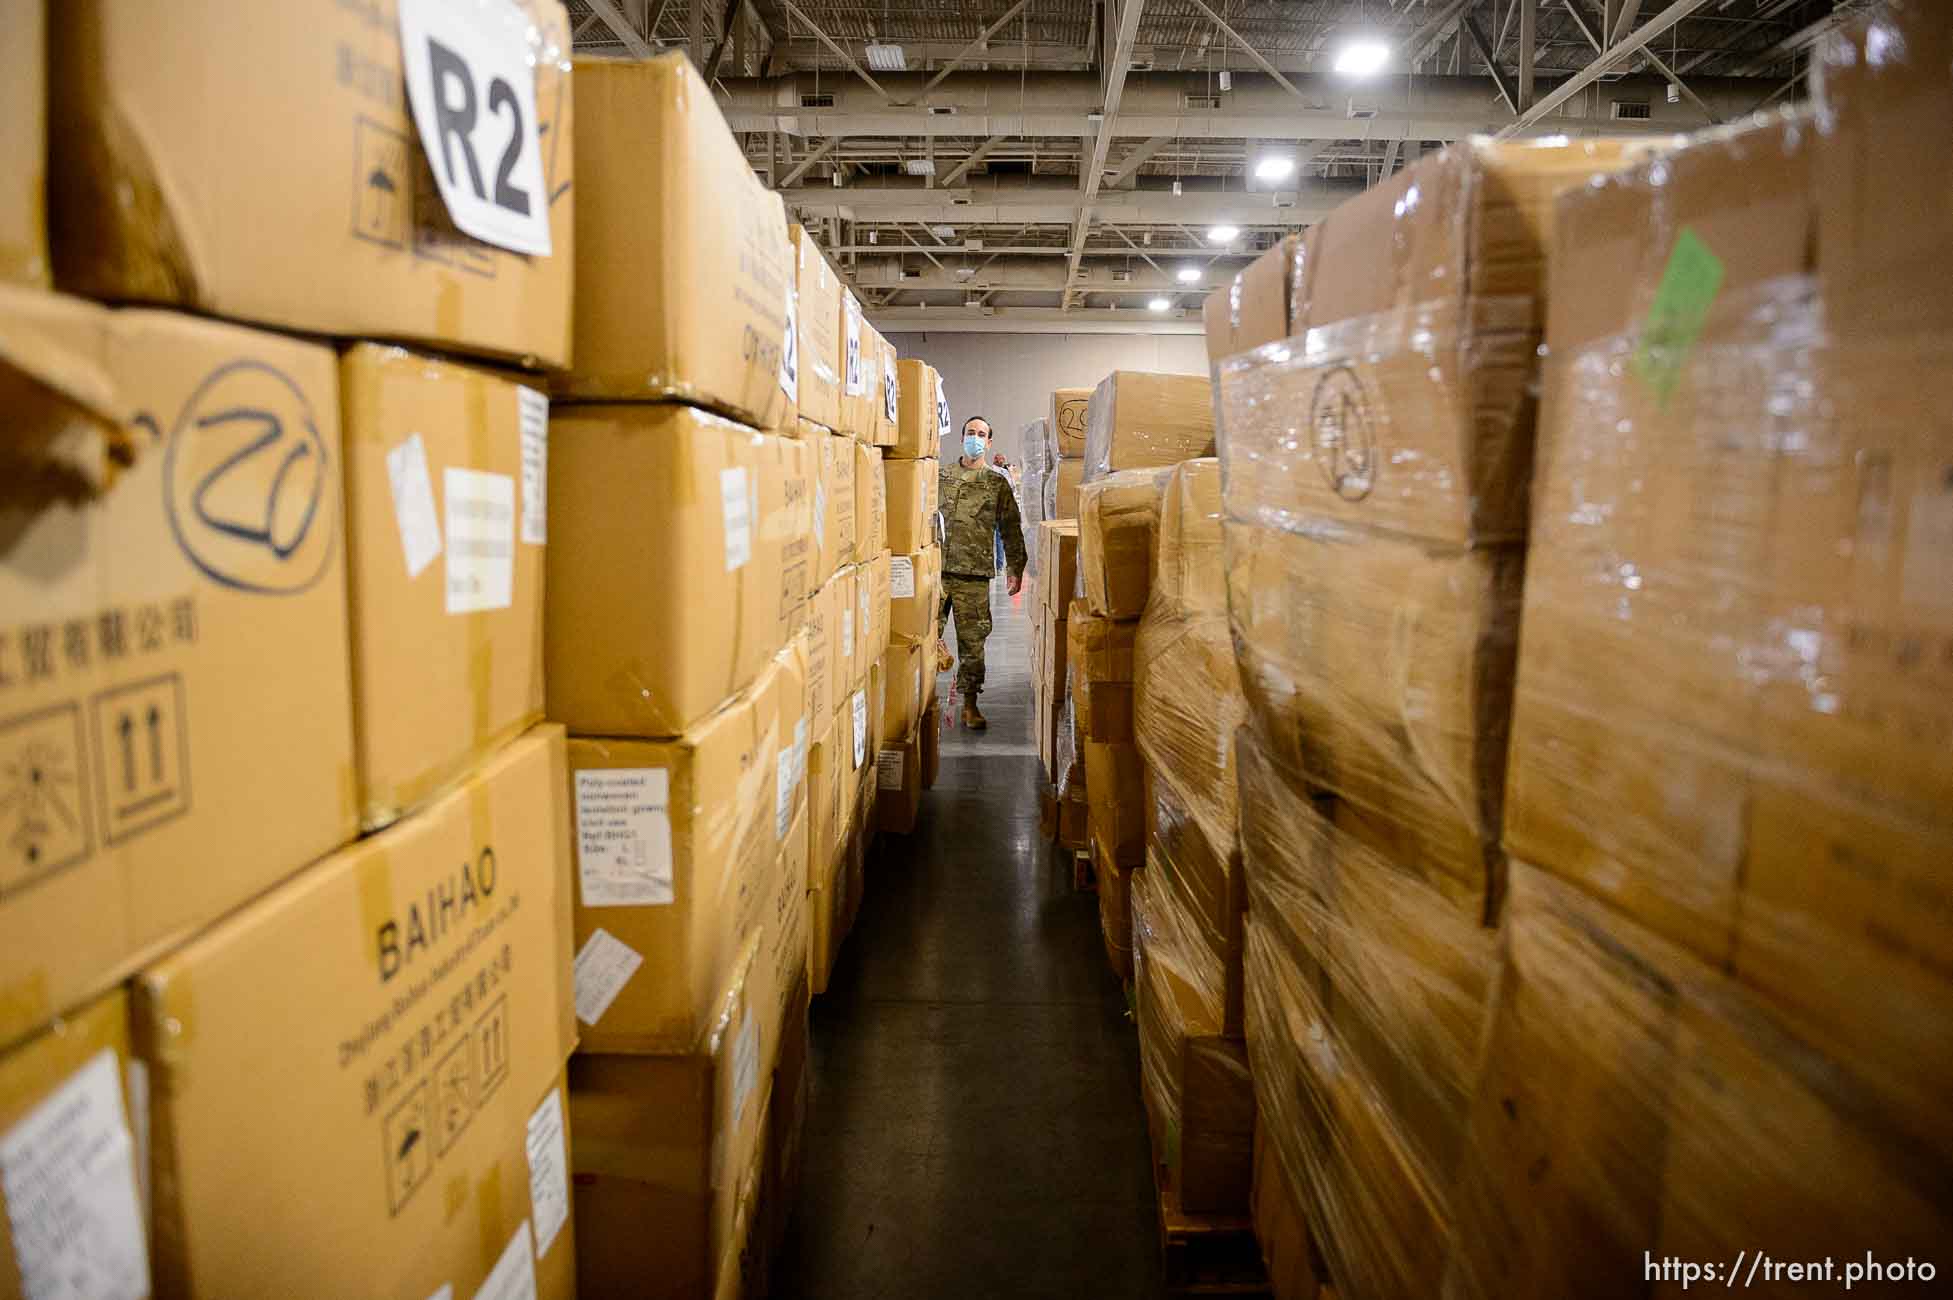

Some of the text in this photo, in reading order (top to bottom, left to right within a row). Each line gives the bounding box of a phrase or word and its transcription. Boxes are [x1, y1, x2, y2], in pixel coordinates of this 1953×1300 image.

[427, 34, 532, 218] R2
[886, 373, 895, 414] R2
[937, 400, 950, 429] R2
[378, 847, 496, 983] BAIHAO
